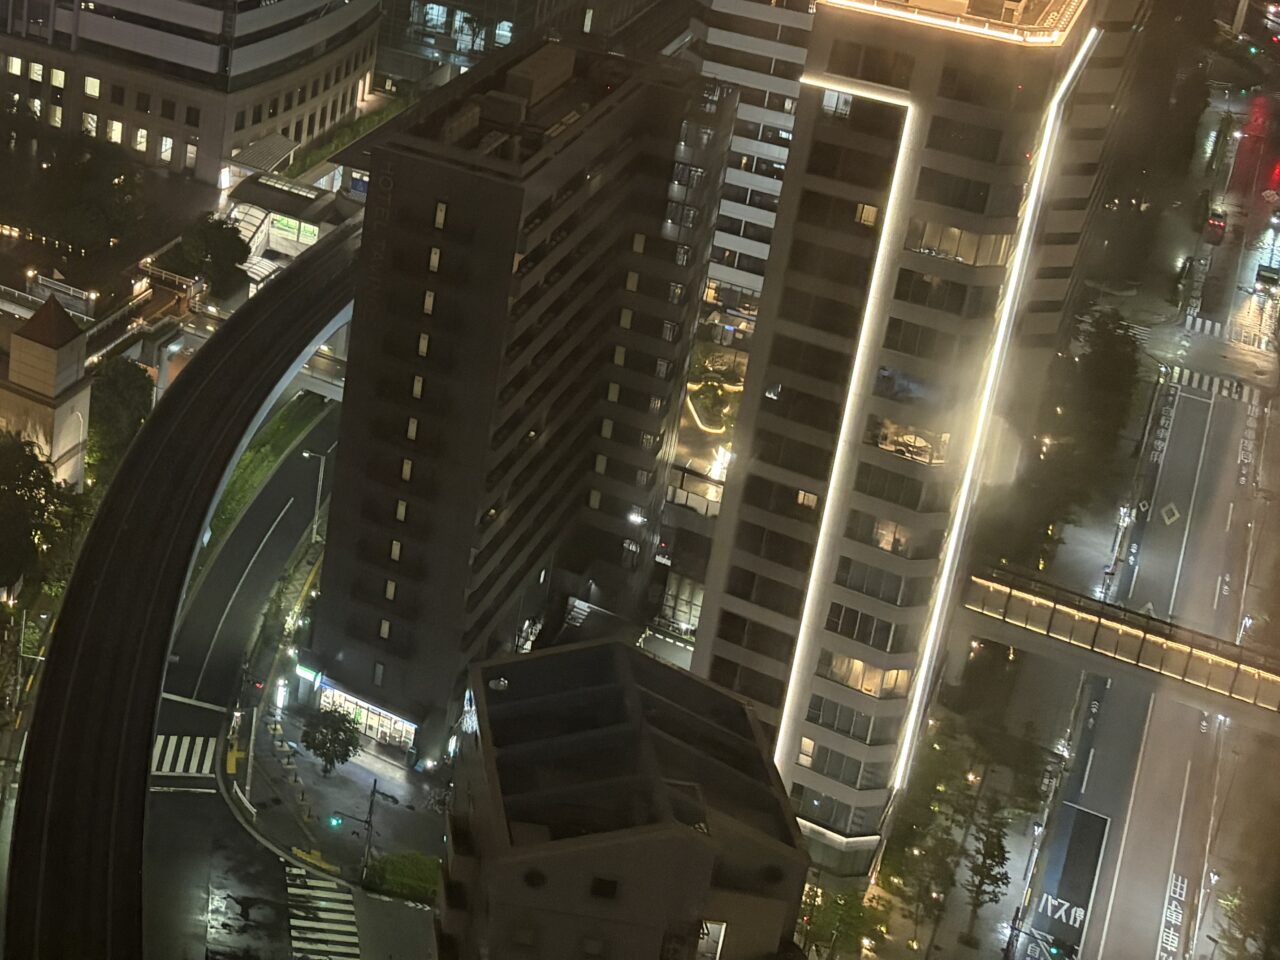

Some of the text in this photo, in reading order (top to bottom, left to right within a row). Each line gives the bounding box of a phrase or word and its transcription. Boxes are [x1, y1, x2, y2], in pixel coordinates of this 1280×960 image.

[374, 160, 395, 231] HOTEL
[1037, 892, 1086, 929] バス停
